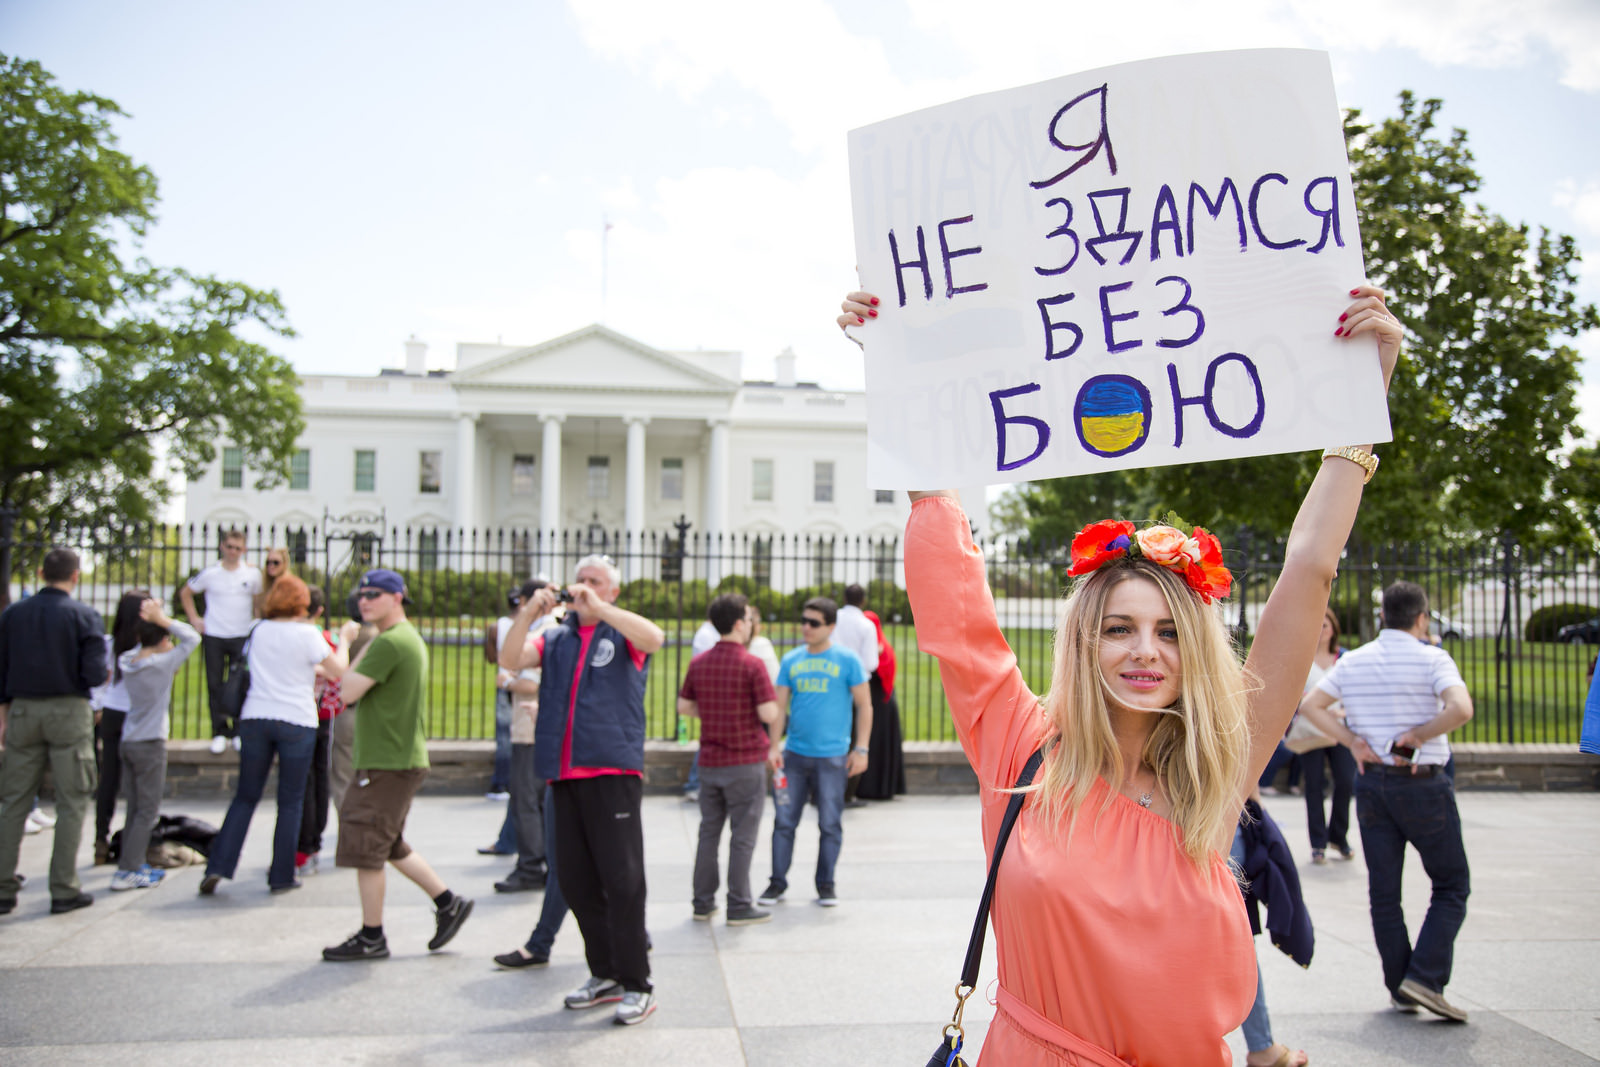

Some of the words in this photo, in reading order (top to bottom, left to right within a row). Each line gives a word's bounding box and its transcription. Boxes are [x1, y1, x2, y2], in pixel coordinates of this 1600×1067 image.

[1029, 82, 1118, 190] Я
[888, 214, 989, 308] НЕ
[1034, 172, 1346, 277] ЗДАМСЯ
[1036, 275, 1206, 362] БЕЗ
[988, 352, 1266, 472] БОЮ
